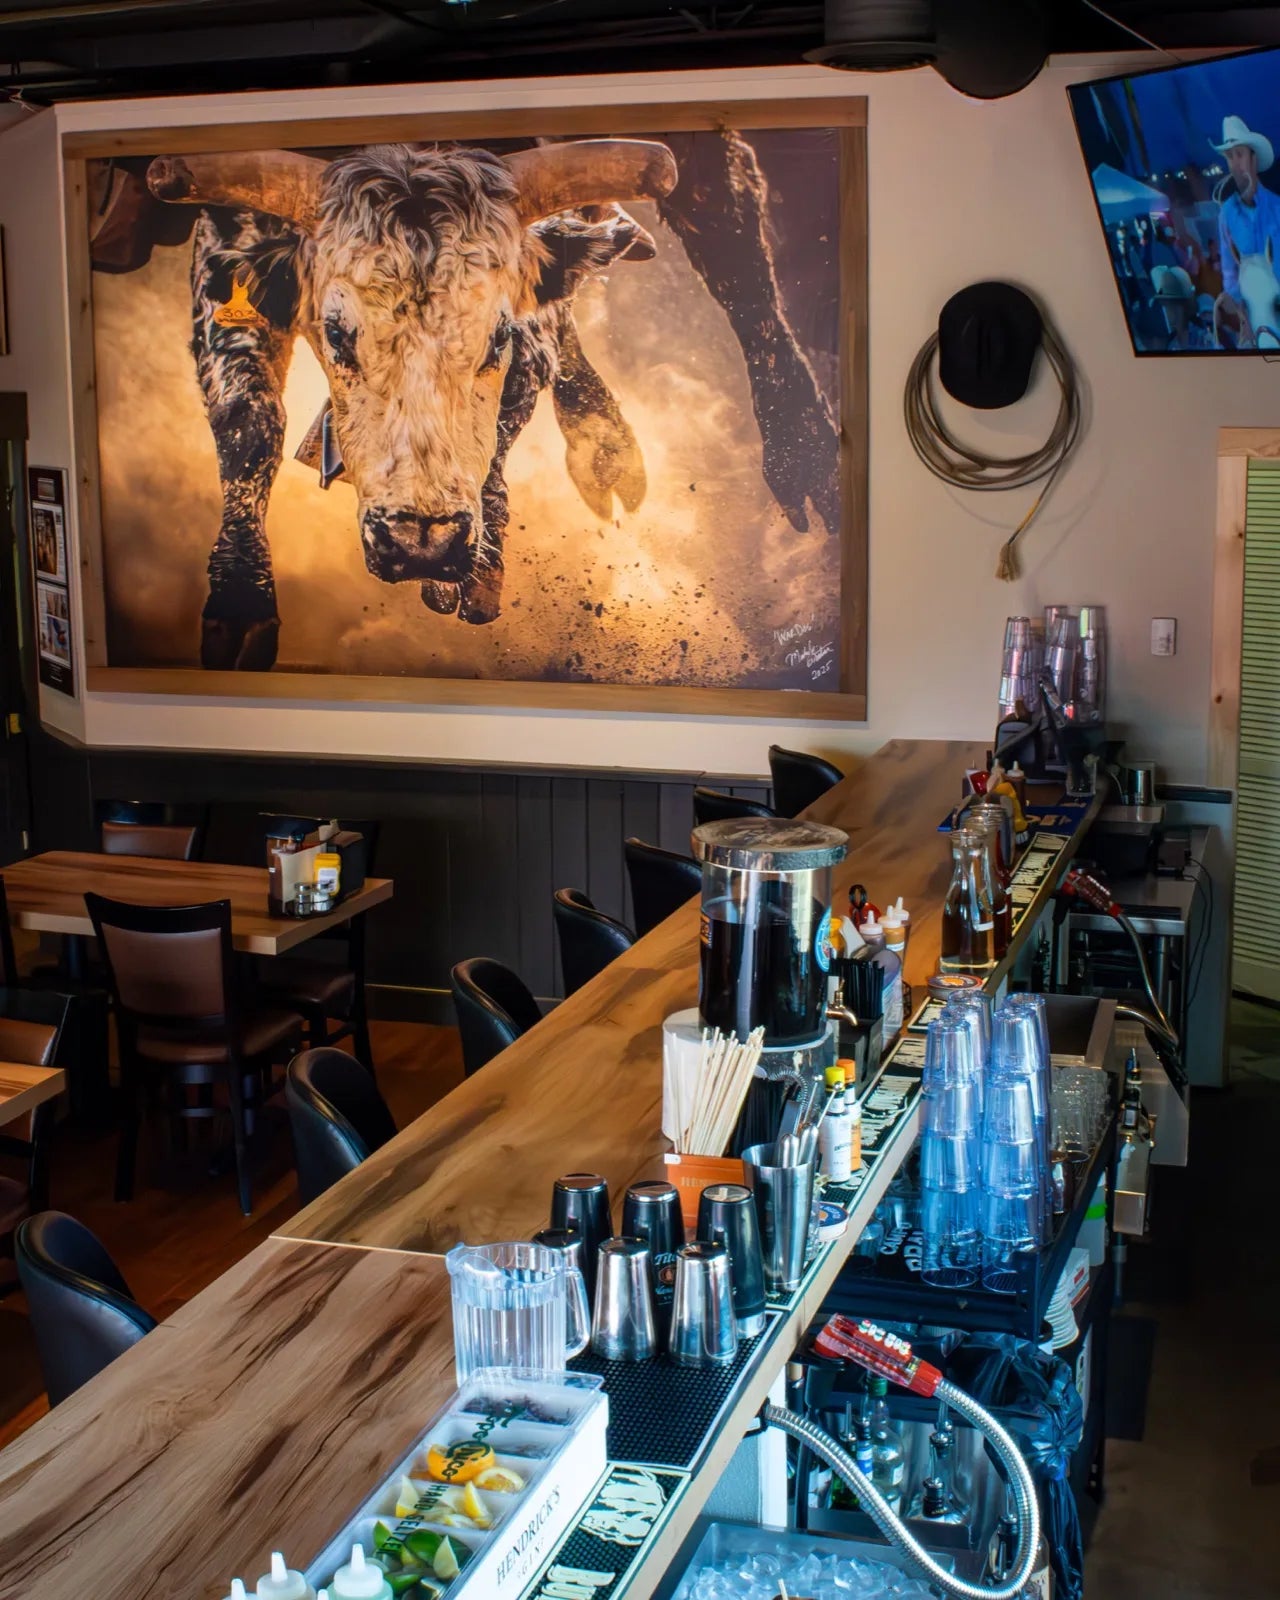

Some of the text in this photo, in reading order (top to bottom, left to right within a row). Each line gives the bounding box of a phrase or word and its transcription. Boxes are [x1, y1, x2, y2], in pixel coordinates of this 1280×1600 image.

[811, 659, 833, 681] 2025
[441, 1440, 491, 1481] Chico
[413, 1483, 450, 1511] HARD
